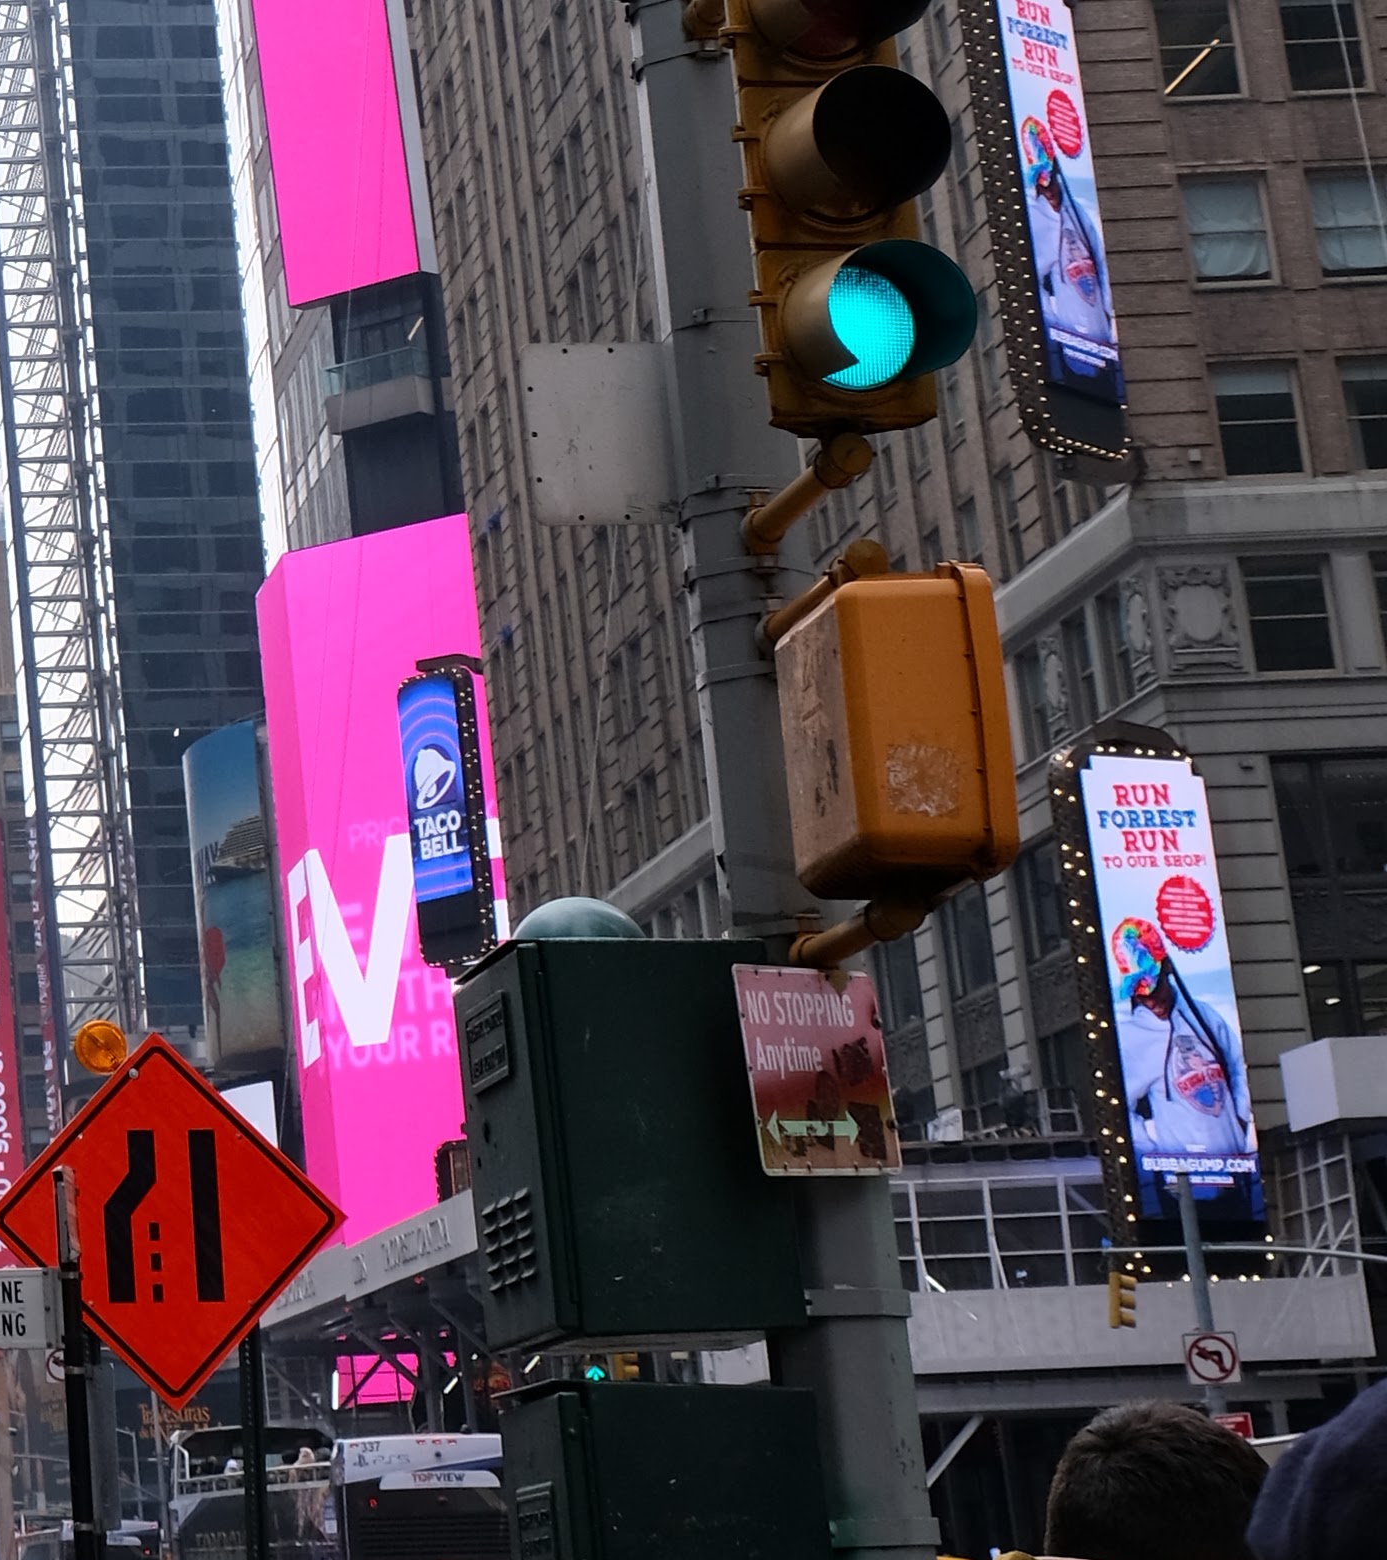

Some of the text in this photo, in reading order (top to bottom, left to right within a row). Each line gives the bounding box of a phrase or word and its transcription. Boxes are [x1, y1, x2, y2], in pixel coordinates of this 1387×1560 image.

[1021, 38, 1059, 69] RUN
[1113, 784, 1171, 807] RUN
[414, 810, 462, 840] TACO
[1097, 809, 1197, 829] FORREST
[419, 834, 464, 861] BELL
[1121, 830, 1180, 853] RUN
[1102, 856, 1123, 869] TO
[1127, 855, 1159, 868] OUR
[746, 990, 855, 1028] NO STOPPING
[756, 1036, 824, 1080] Anytime
[361, 1441, 381, 1453] 337
[412, 1472, 465, 1483] TOPVIEW
